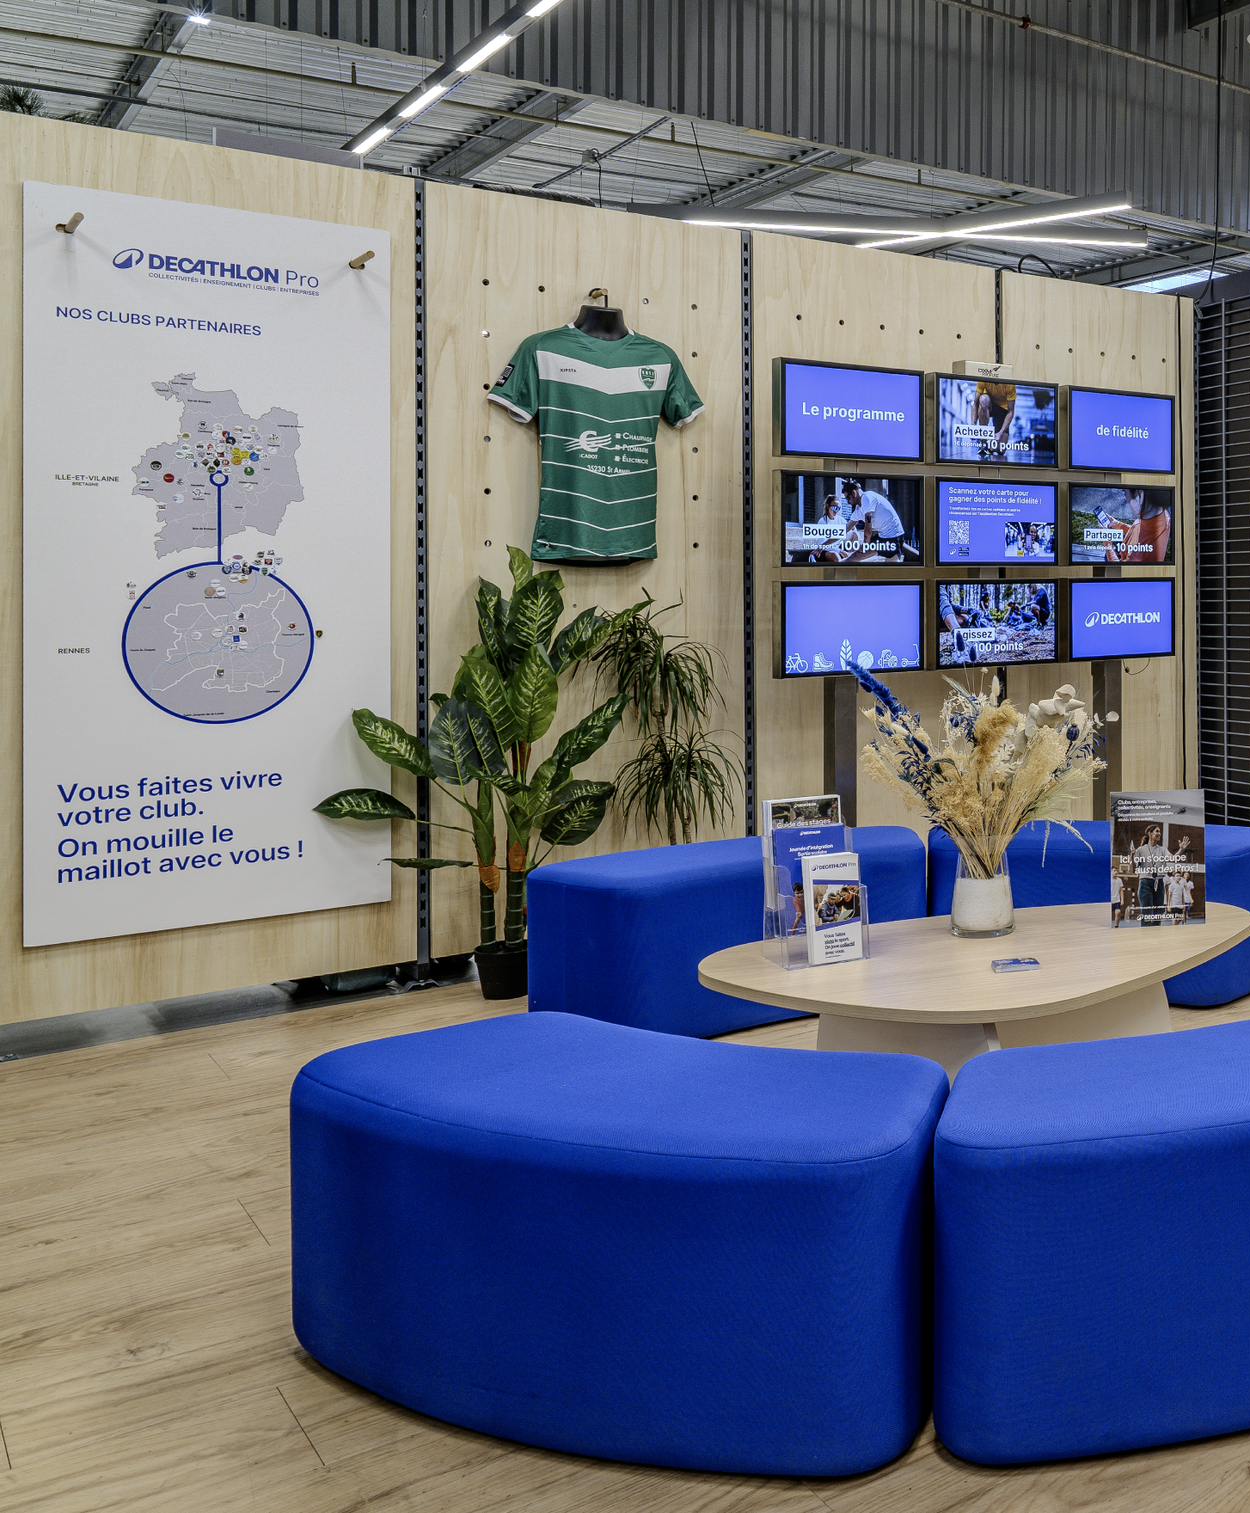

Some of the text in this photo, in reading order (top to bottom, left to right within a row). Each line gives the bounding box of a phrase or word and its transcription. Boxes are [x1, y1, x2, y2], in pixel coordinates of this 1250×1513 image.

[148, 253, 319, 288] DECATHLON Pro
[148, 272, 200, 283] COLLECTIVITÉS
[202, 279, 251, 289] ENSEIGNEMENT
[280, 287, 320, 296] ENTREPRISES
[56, 306, 262, 337] NOS CLUBS PARTENAIRES
[802, 402, 904, 423] Le programme
[954, 426, 994, 438] Achetez
[1096, 424, 1149, 440] de fidélité
[986, 440, 998, 450] 10
[1000, 442, 1030, 451] points
[55, 474, 120, 482] ILLE-ET-VILAINE
[804, 526, 844, 538] Bougez
[1086, 530, 1122, 540] Partagez
[840, 540, 860, 550] 100
[862, 540, 896, 554] points
[1116, 543, 1153, 554] 10 points
[1101, 612, 1160, 625] DECATHLON
[958, 630, 992, 640] gissez
[974, 642, 1024, 653] 100 points
[57, 770, 283, 804] Vous faites vivre
[57, 799, 204, 827] votre club.
[58, 824, 234, 858] On mouille le
[58, 840, 303, 884] maillot avec vous !
[1120, 855, 1132, 864] Ici,
[1147, 854, 1186, 864] s'occupe
[1135, 865, 1156, 874] aussi
[1175, 864, 1194, 872] Pros
[1196, 863, 1198, 871] !
